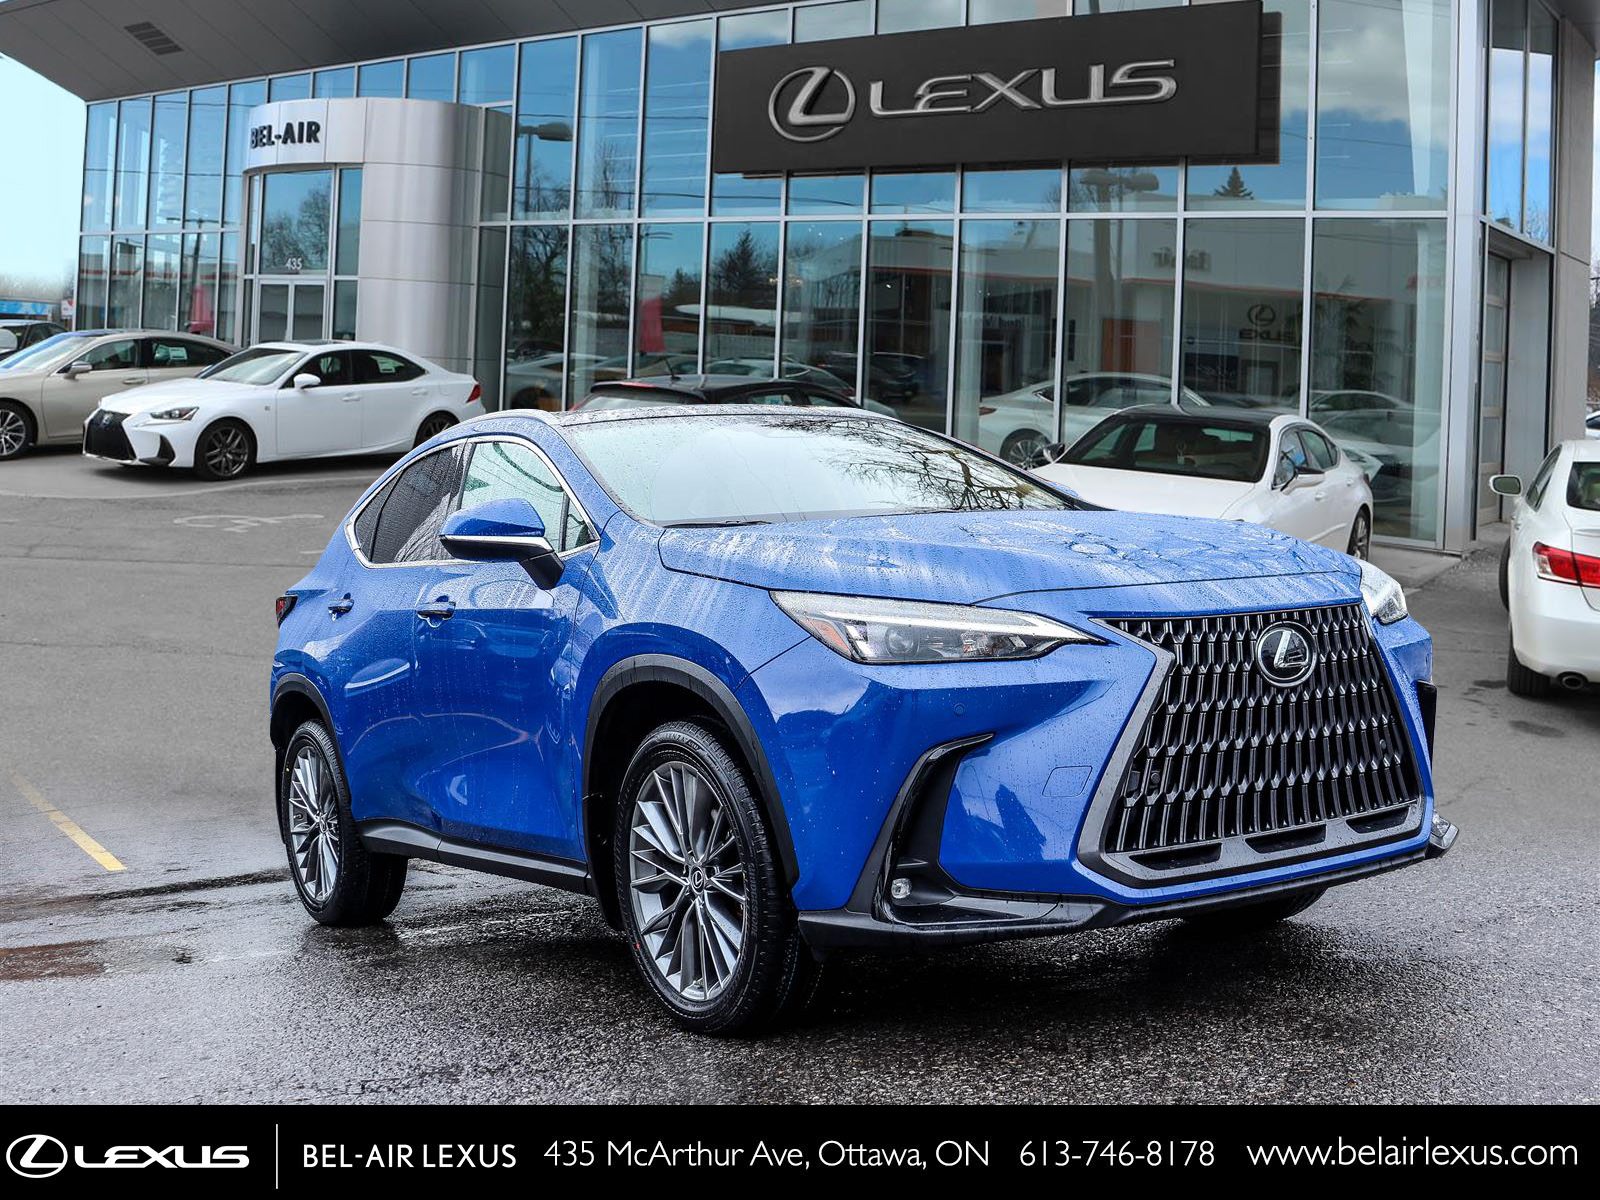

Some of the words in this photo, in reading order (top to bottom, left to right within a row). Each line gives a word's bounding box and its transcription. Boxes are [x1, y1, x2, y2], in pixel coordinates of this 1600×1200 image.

[869, 59, 1177, 118] LEXUS
[250, 121, 321, 149] BEL-AIR
[285, 257, 303, 270] 435
